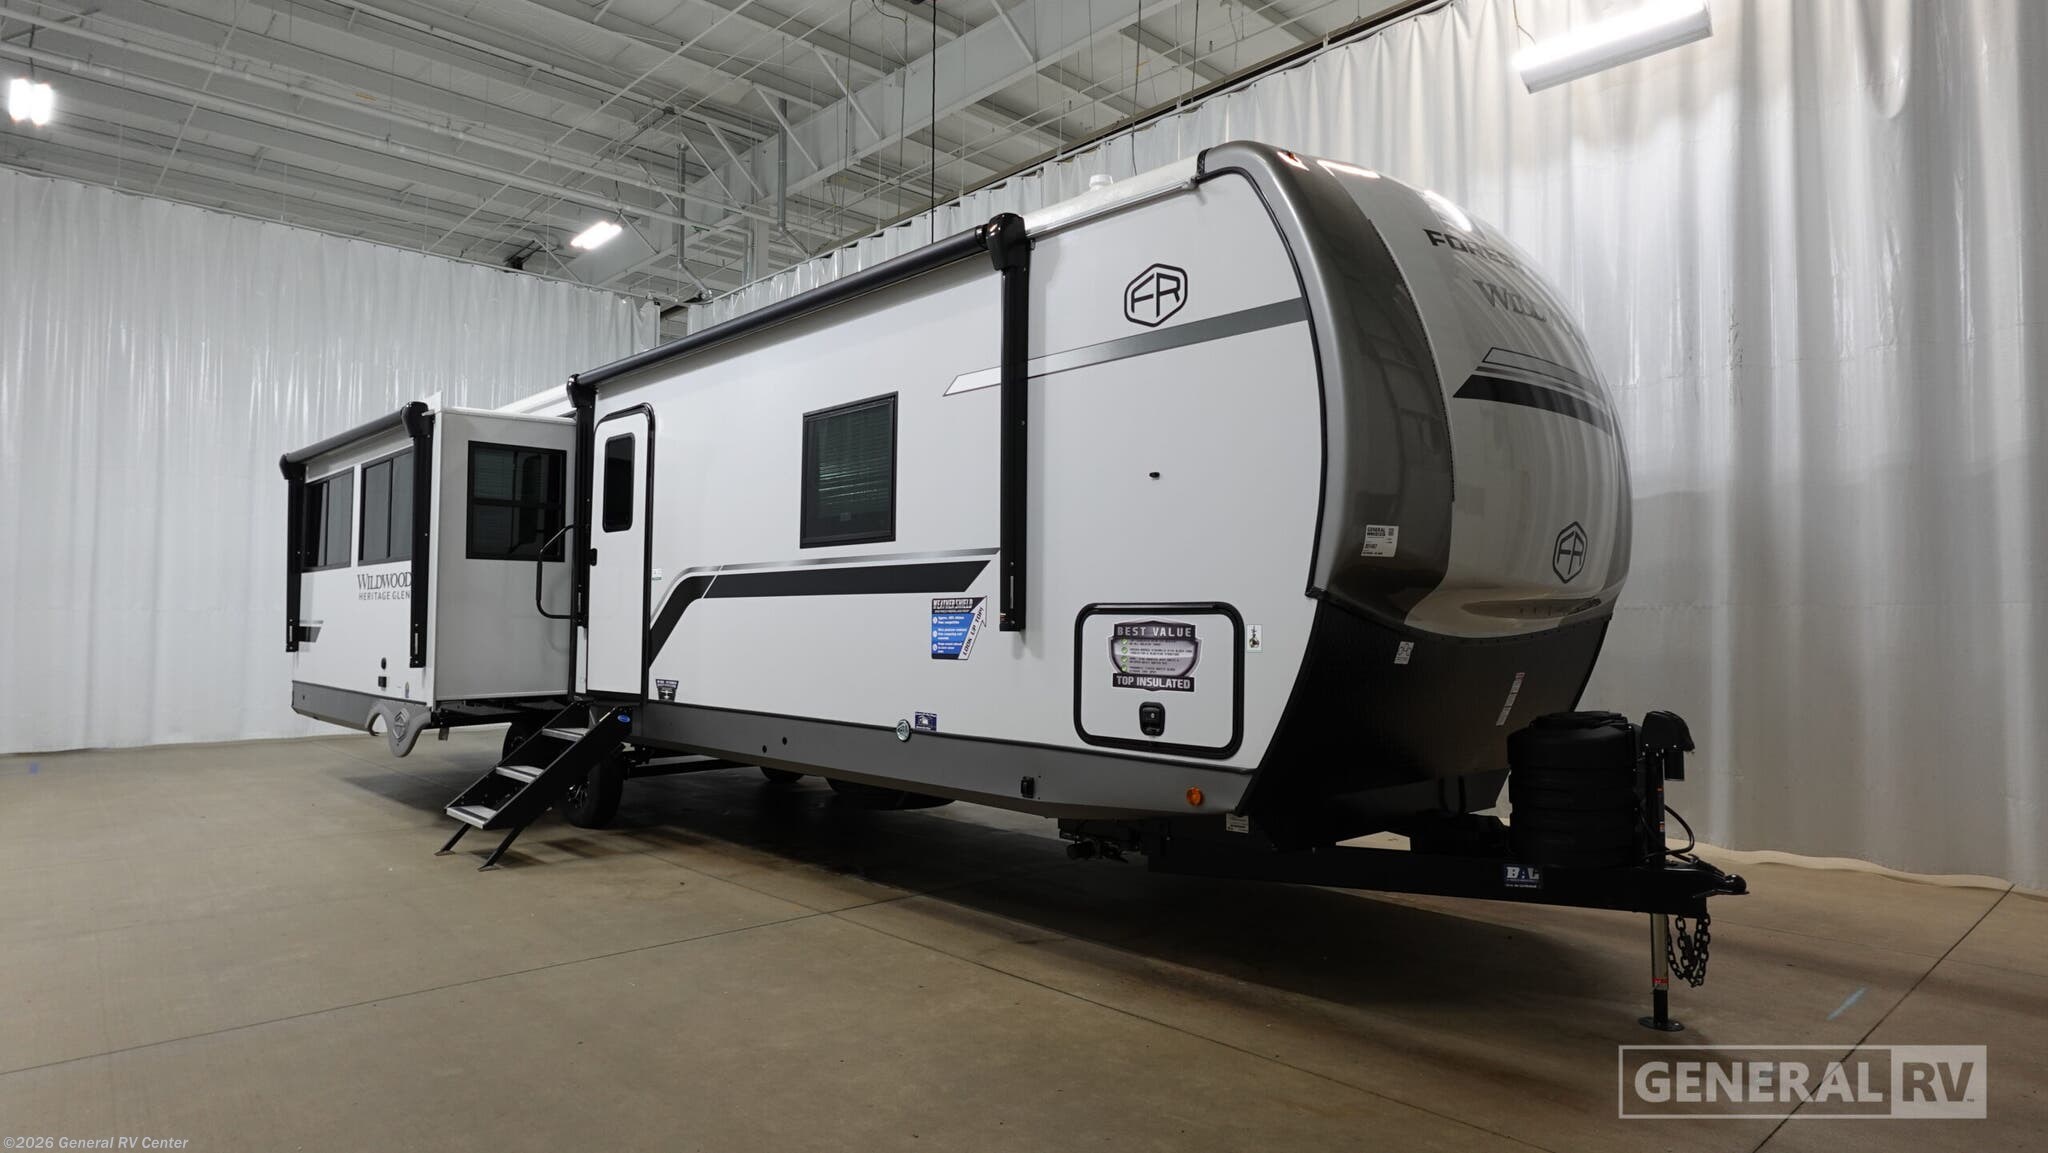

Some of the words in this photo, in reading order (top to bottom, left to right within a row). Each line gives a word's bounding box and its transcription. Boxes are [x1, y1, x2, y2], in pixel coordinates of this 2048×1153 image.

[357, 571, 412, 590] WILDWOOD
[359, 591, 391, 600] HERITAGE
[391, 590, 411, 600] GLEN
[970, 624, 977, 636] UP
[1117, 626, 1147, 636] BEST
[1152, 626, 1192, 638] VALUE
[1116, 675, 1135, 686] TOP
[1136, 676, 1191, 690] INSULATED
